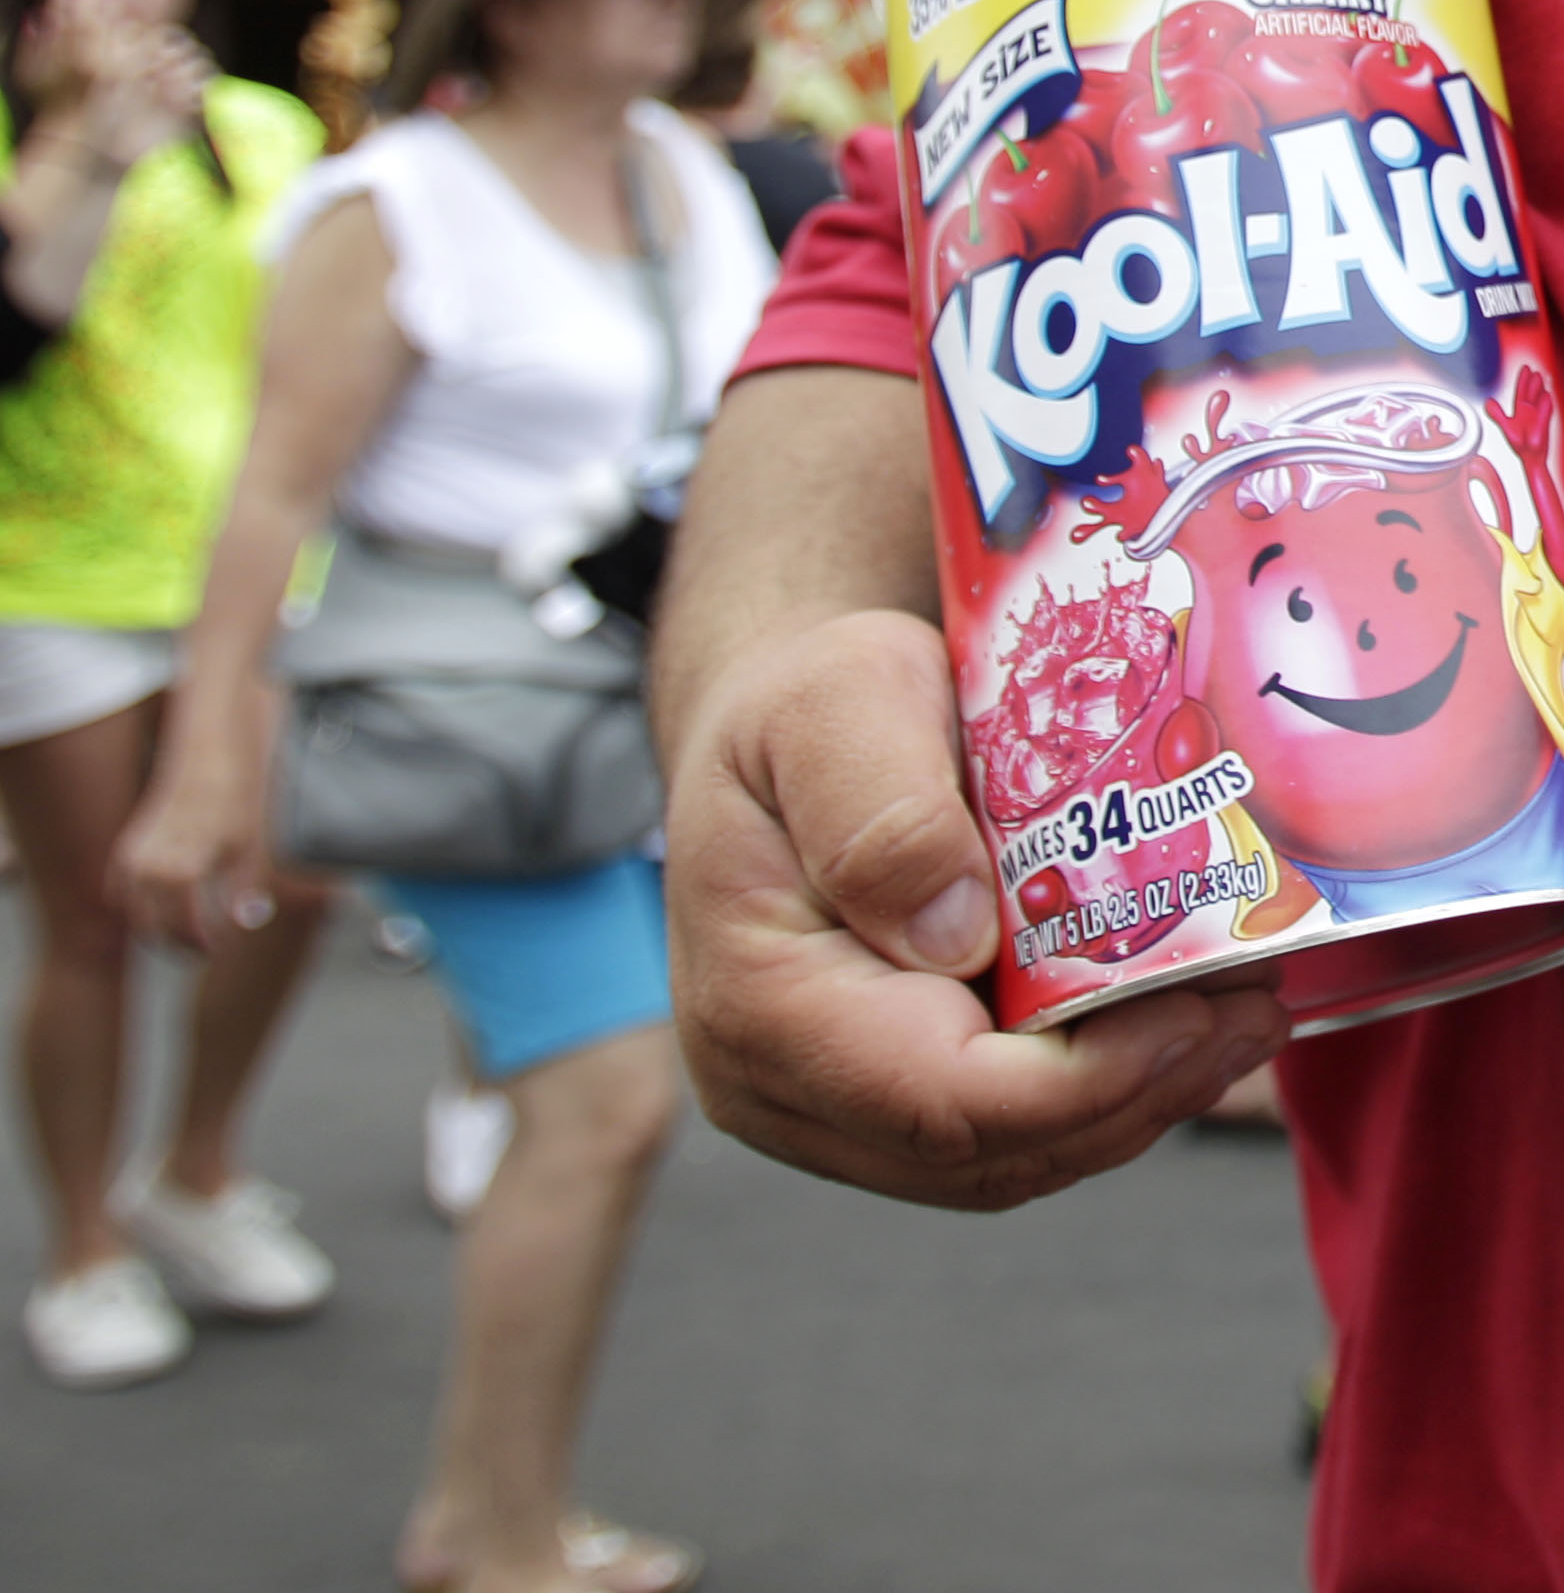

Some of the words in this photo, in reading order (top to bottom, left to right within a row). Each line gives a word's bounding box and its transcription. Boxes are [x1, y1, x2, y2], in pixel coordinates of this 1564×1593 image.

[1254, 11, 1355, 40] ARTIFICIAL
[1355, 15, 1420, 48] FLAVOR
[925, 87, 971, 177] NEW
[931, 76, 1521, 525] Kool-Aid
[1475, 283, 1521, 318] DRINK
[1000, 818, 1066, 892] MAKES
[1067, 788, 1133, 862] 34
[1137, 758, 1247, 835] QUARTS
[1013, 926, 1038, 969] NET
[1037, 916, 1064, 957] WT
[1065, 910, 1081, 947] 5
[1080, 901, 1107, 942] LB
[1108, 889, 1141, 932] 2.5
[1145, 878, 1175, 920] OZ
[1178, 851, 1267, 915] (2.33kg)
